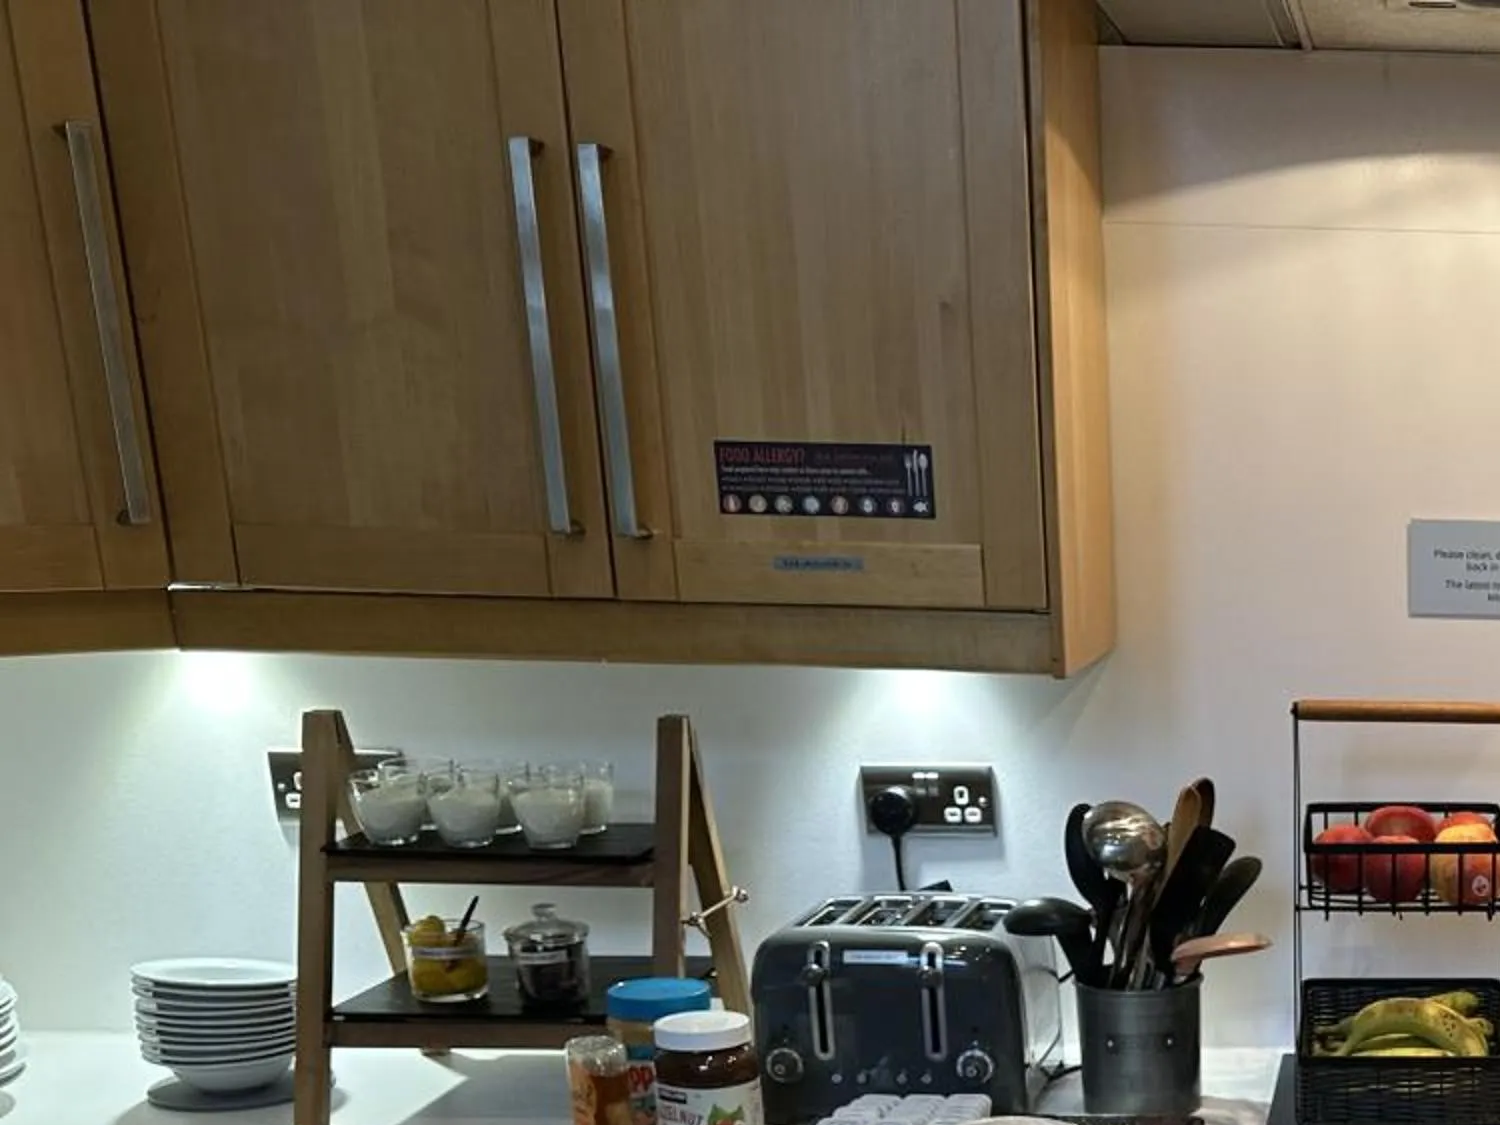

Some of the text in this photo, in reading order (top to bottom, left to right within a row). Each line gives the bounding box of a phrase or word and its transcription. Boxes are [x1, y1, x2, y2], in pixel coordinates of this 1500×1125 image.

[1433, 549, 1464, 560] Please
[1466, 562, 1488, 572] back
[1490, 562, 1500, 572] in
[1445, 579, 1463, 590] The
[1464, 580, 1490, 590] latest
